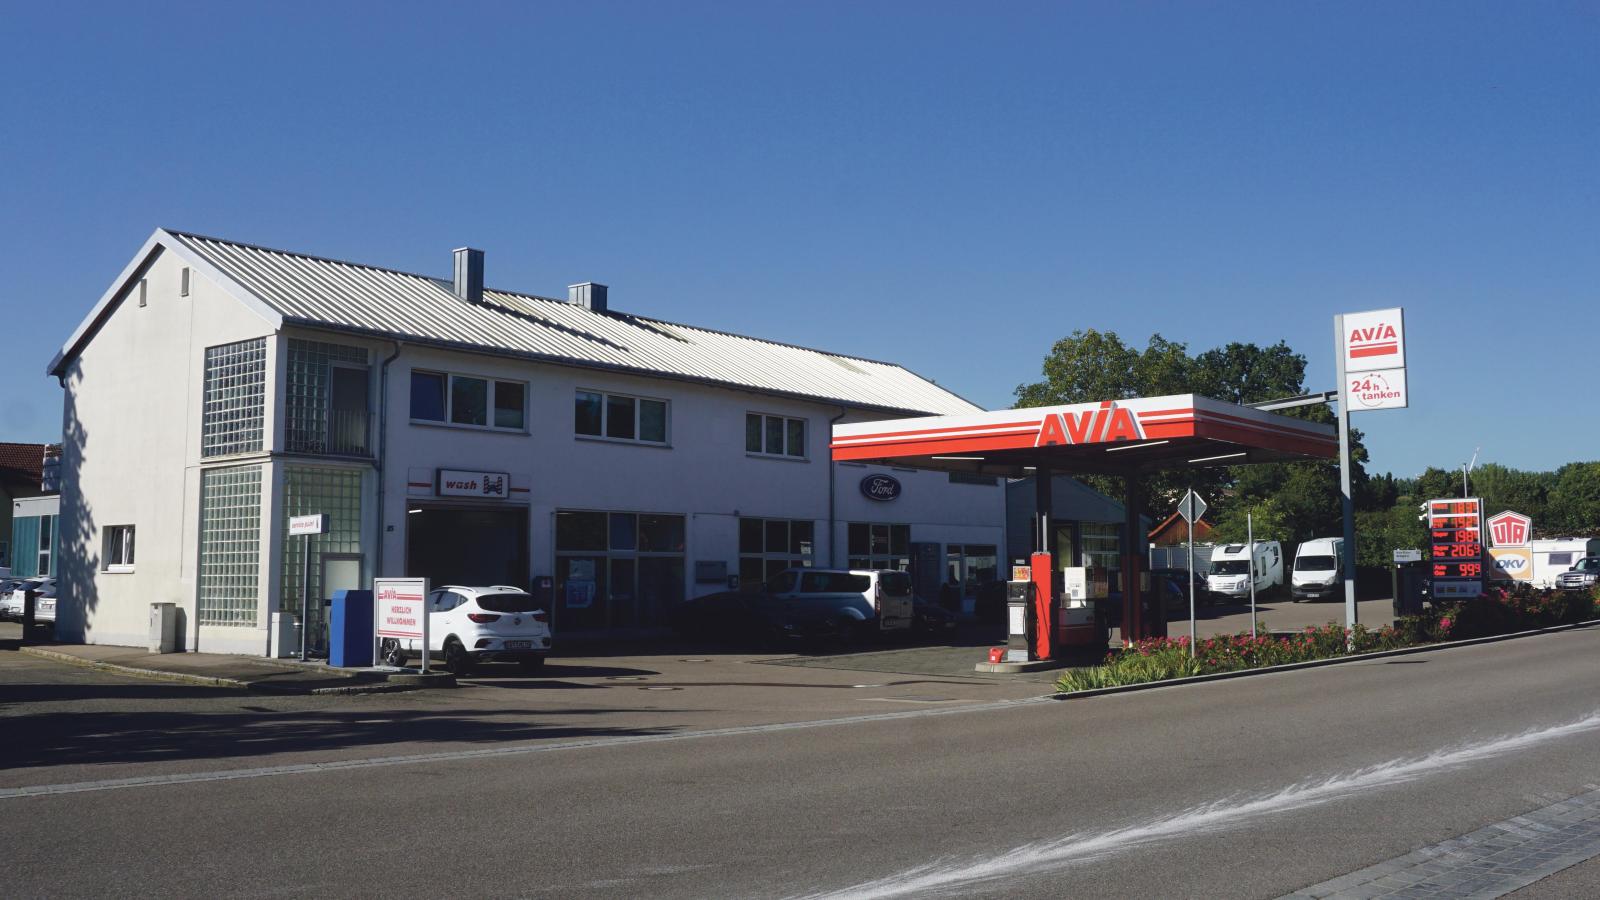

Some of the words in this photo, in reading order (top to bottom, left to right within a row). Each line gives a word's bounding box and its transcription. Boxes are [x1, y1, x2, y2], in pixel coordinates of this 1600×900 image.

[1351, 380, 1371, 392] 24
[1362, 391, 1400, 400] tanken
[446, 481, 477, 490] wash
[871, 479, 894, 495] Ford
[1492, 516, 1526, 544] UTA
[1495, 560, 1525, 569] DKV
[391, 606, 412, 614] HERZLICH
[387, 617, 416, 626] WILLKOMMEN
